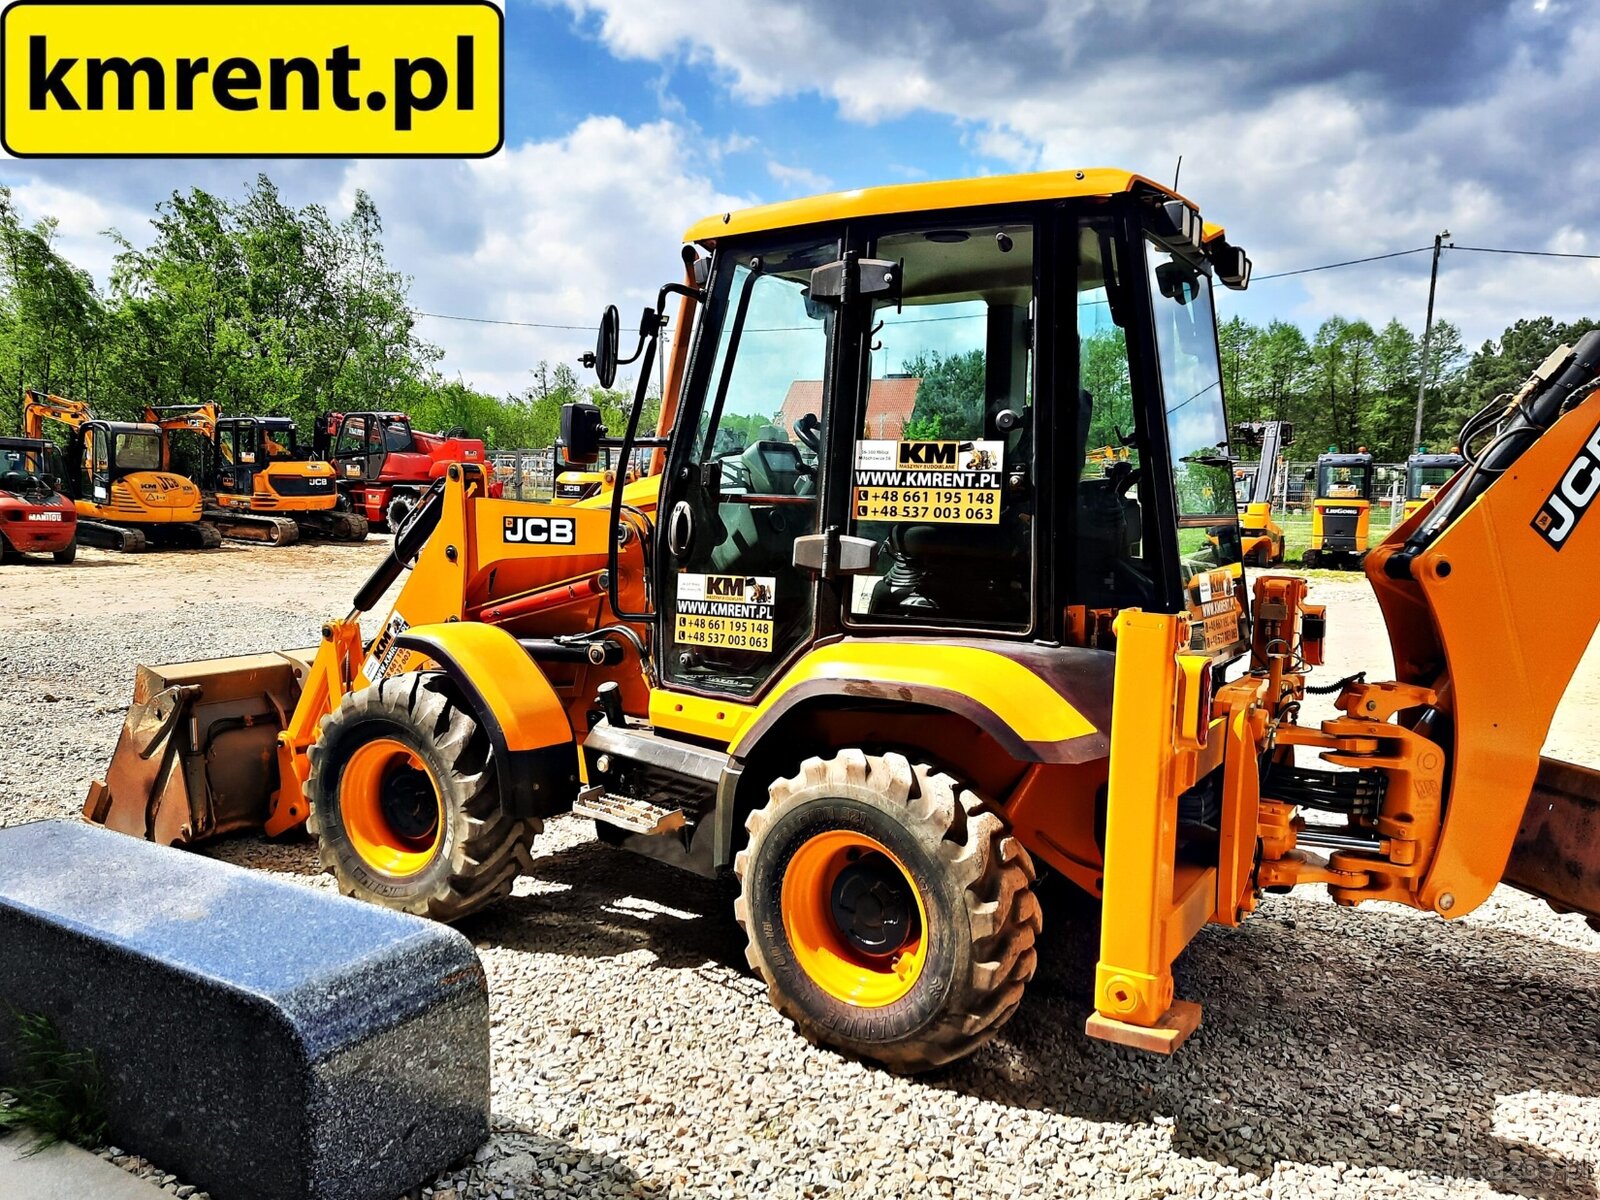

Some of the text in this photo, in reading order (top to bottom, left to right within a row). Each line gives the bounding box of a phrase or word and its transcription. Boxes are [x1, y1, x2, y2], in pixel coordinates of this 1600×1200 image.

[899, 442, 957, 464] KM
[309, 478, 327, 486] JCB
[855, 471, 1000, 488] WWW.KMRENT.PL
[871, 490, 994, 504] +48 661 195 148
[28, 512, 62, 521] MANITOU
[871, 505, 993, 519] +48 537 003 063
[505, 518, 573, 543] JCB
[707, 577, 744, 596] KM
[677, 601, 773, 619] WWW.KMRENT.PL
[688, 618, 769, 634] +48 661 195 148
[373, 630, 391, 660] KM
[687, 631, 768, 648] +48 537 003 063
